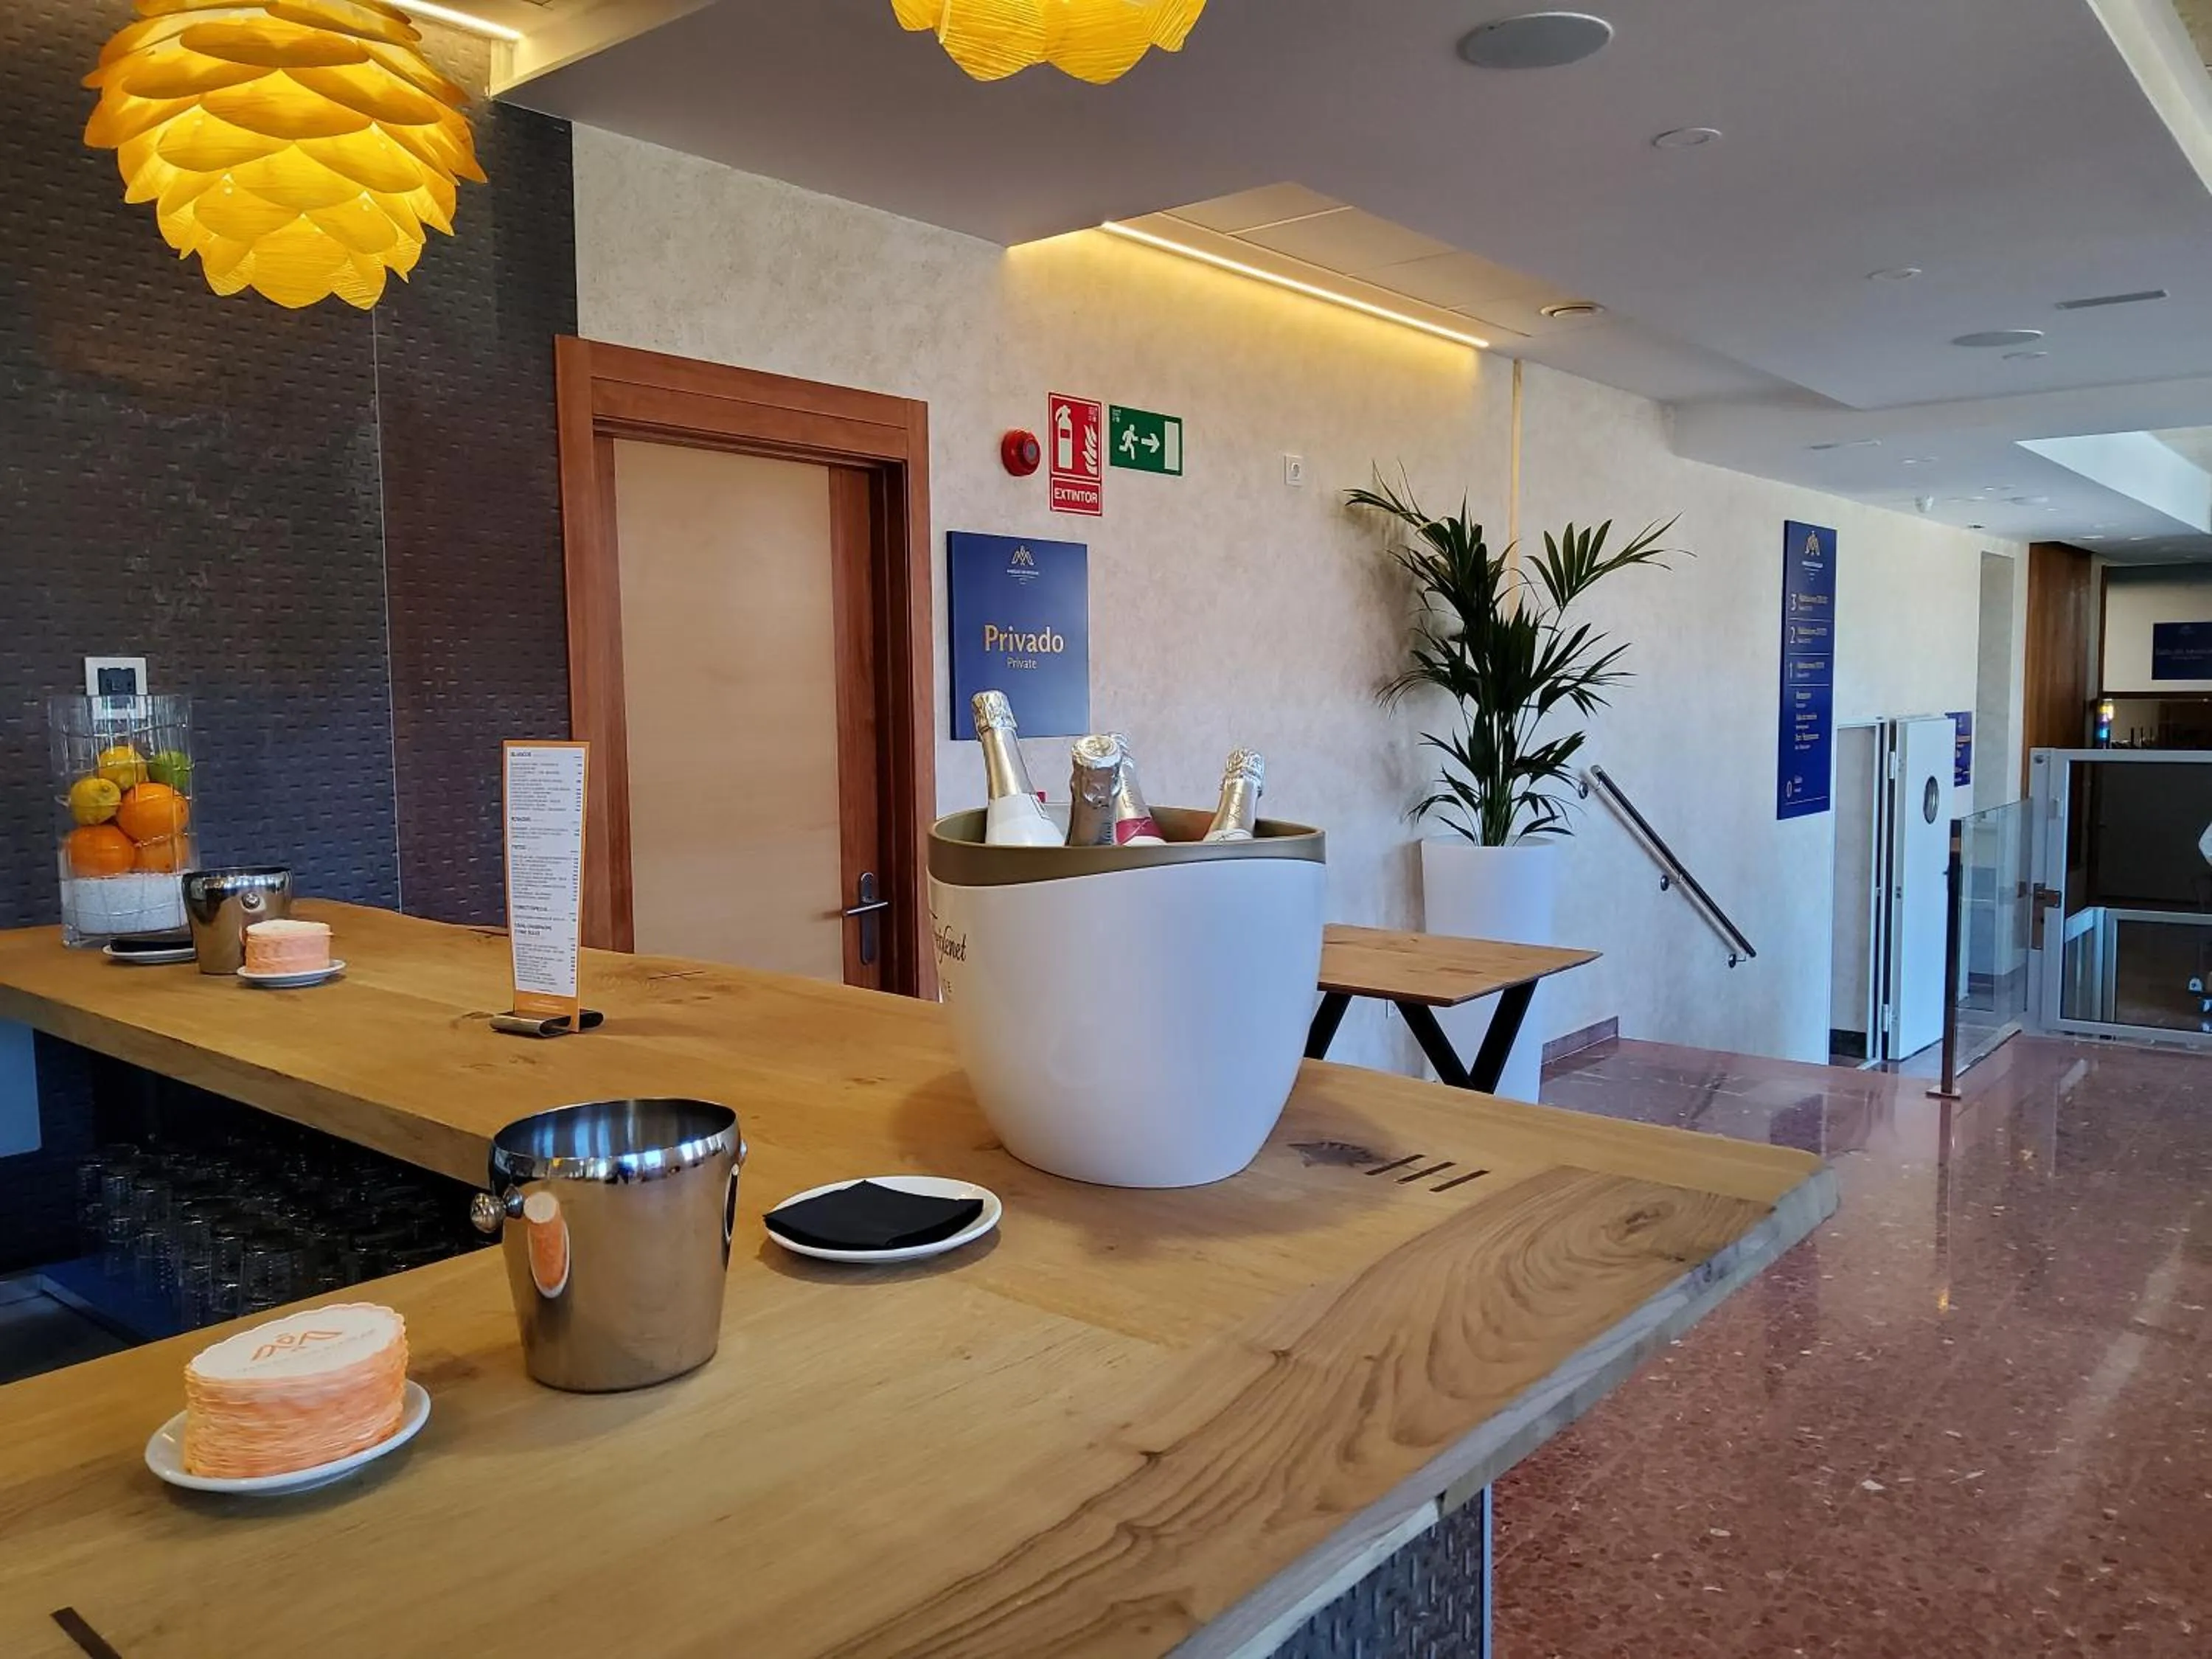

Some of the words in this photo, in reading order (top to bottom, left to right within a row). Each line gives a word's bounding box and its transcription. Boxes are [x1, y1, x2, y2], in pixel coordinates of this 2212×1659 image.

[1054, 487, 1097, 504] EXTINTOR
[1791, 593, 1797, 611] 3
[984, 625, 1064, 653] Privado
[1790, 626, 1795, 644] 2
[1006, 657, 1037, 669] Private
